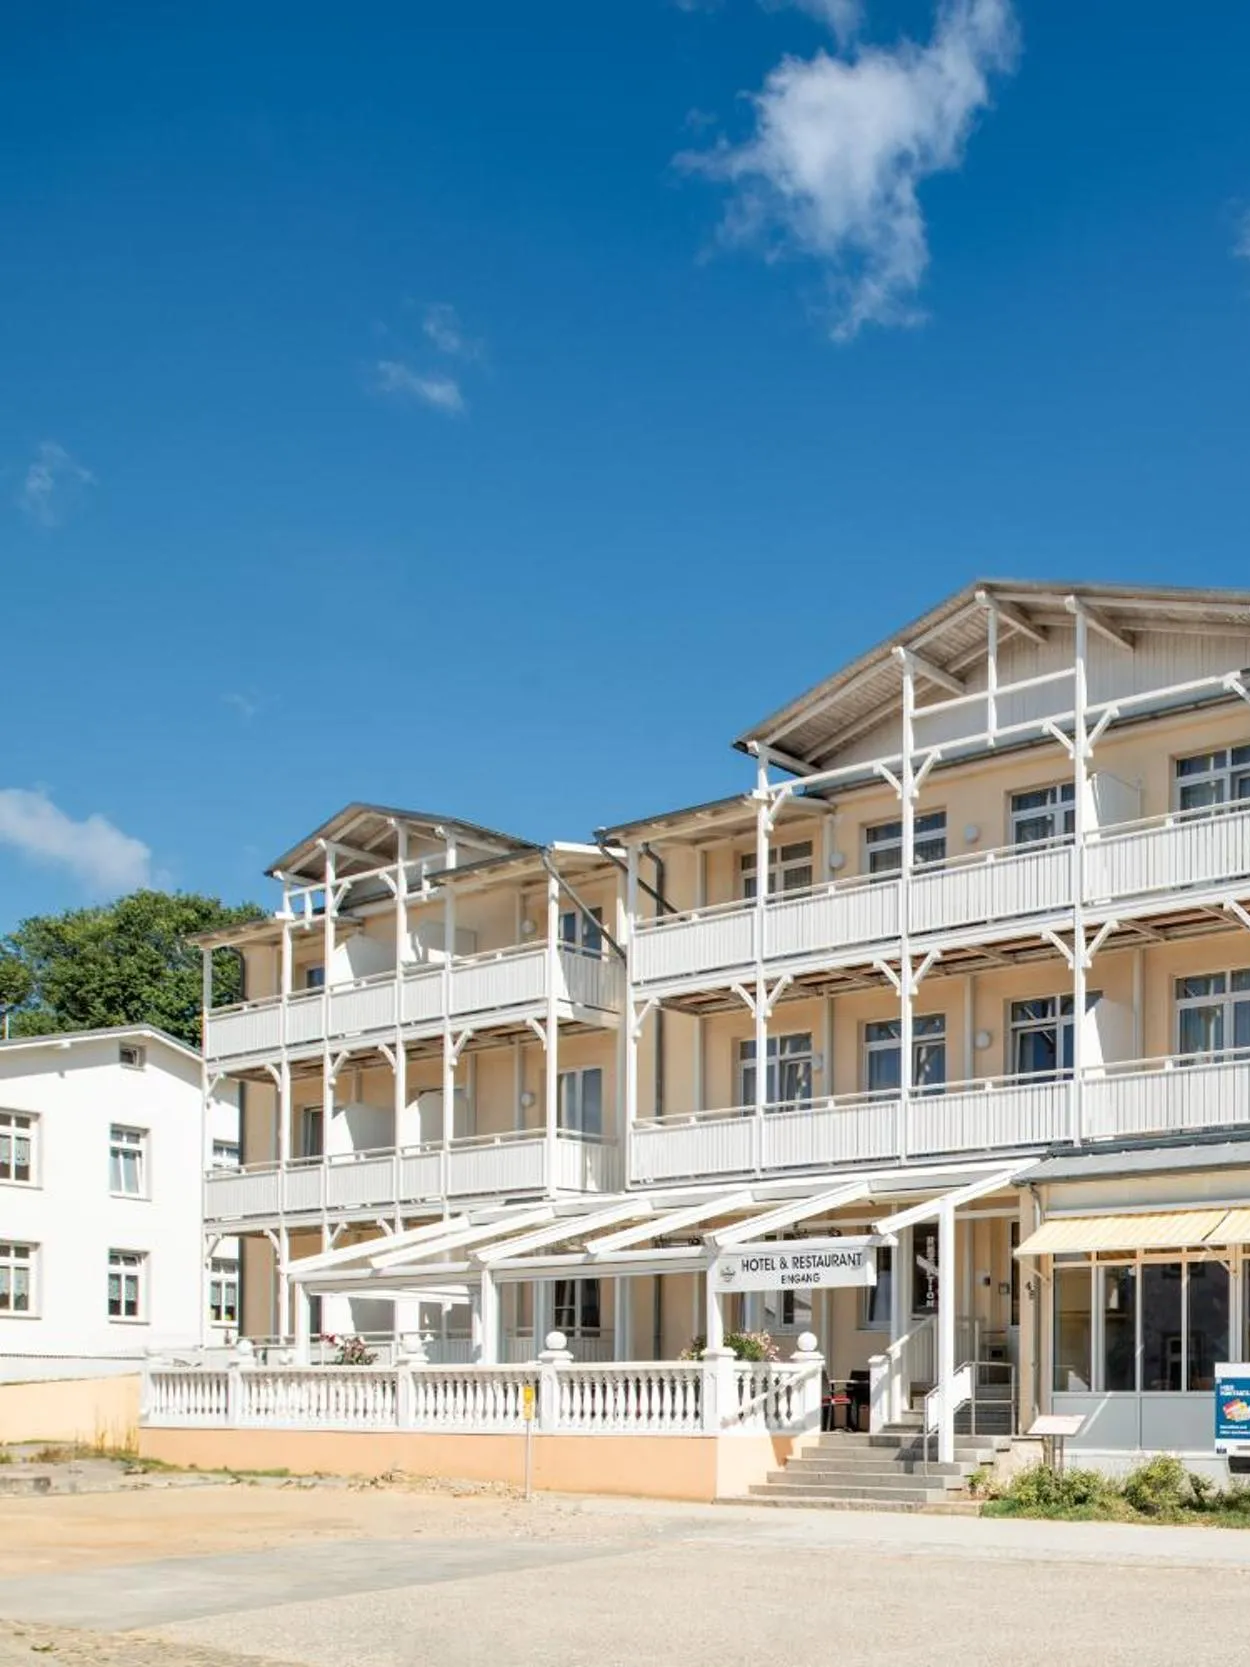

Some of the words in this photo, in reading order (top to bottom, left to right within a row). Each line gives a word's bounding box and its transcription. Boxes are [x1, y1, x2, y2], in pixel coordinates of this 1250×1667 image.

[741, 1258, 776, 1272] HOTEL
[779, 1256, 789, 1270] &
[791, 1252, 863, 1270] RESTAURANT
[781, 1273, 821, 1285] ENGANG
